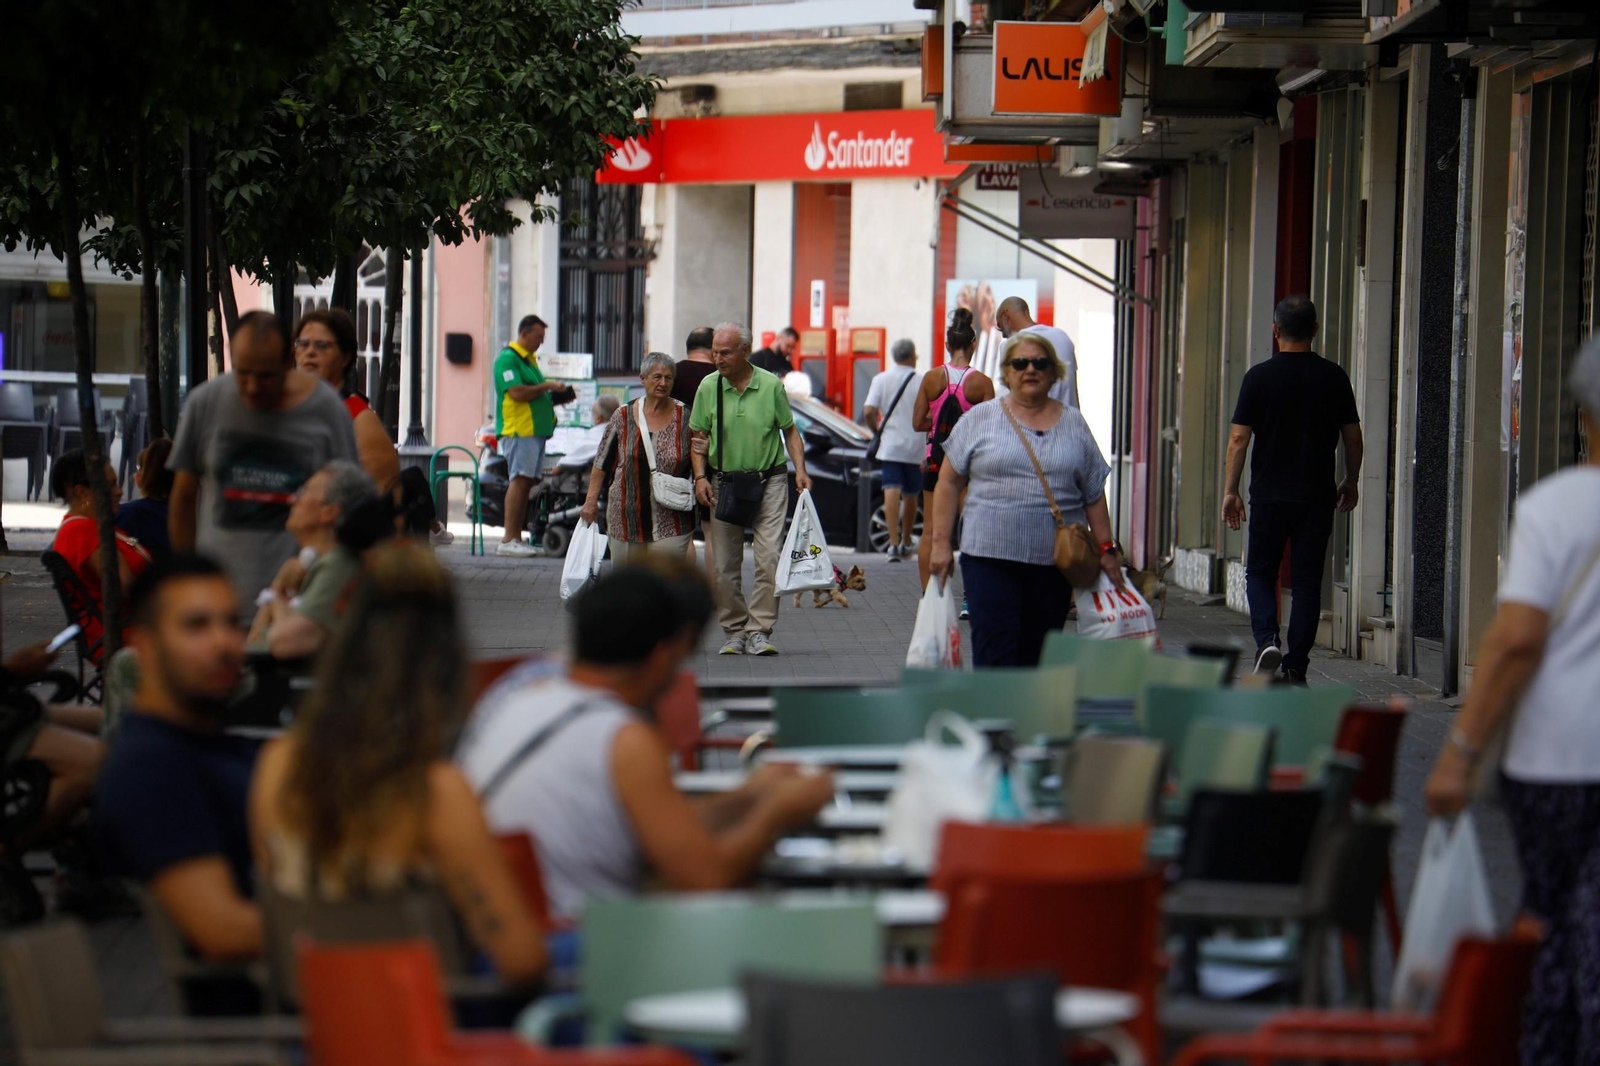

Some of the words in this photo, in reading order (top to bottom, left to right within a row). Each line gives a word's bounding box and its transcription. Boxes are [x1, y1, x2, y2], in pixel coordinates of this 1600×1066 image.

[1002, 57, 1112, 80] LALIS
[827, 129, 914, 169] Santander
[1120, 609, 1147, 620] MODA
